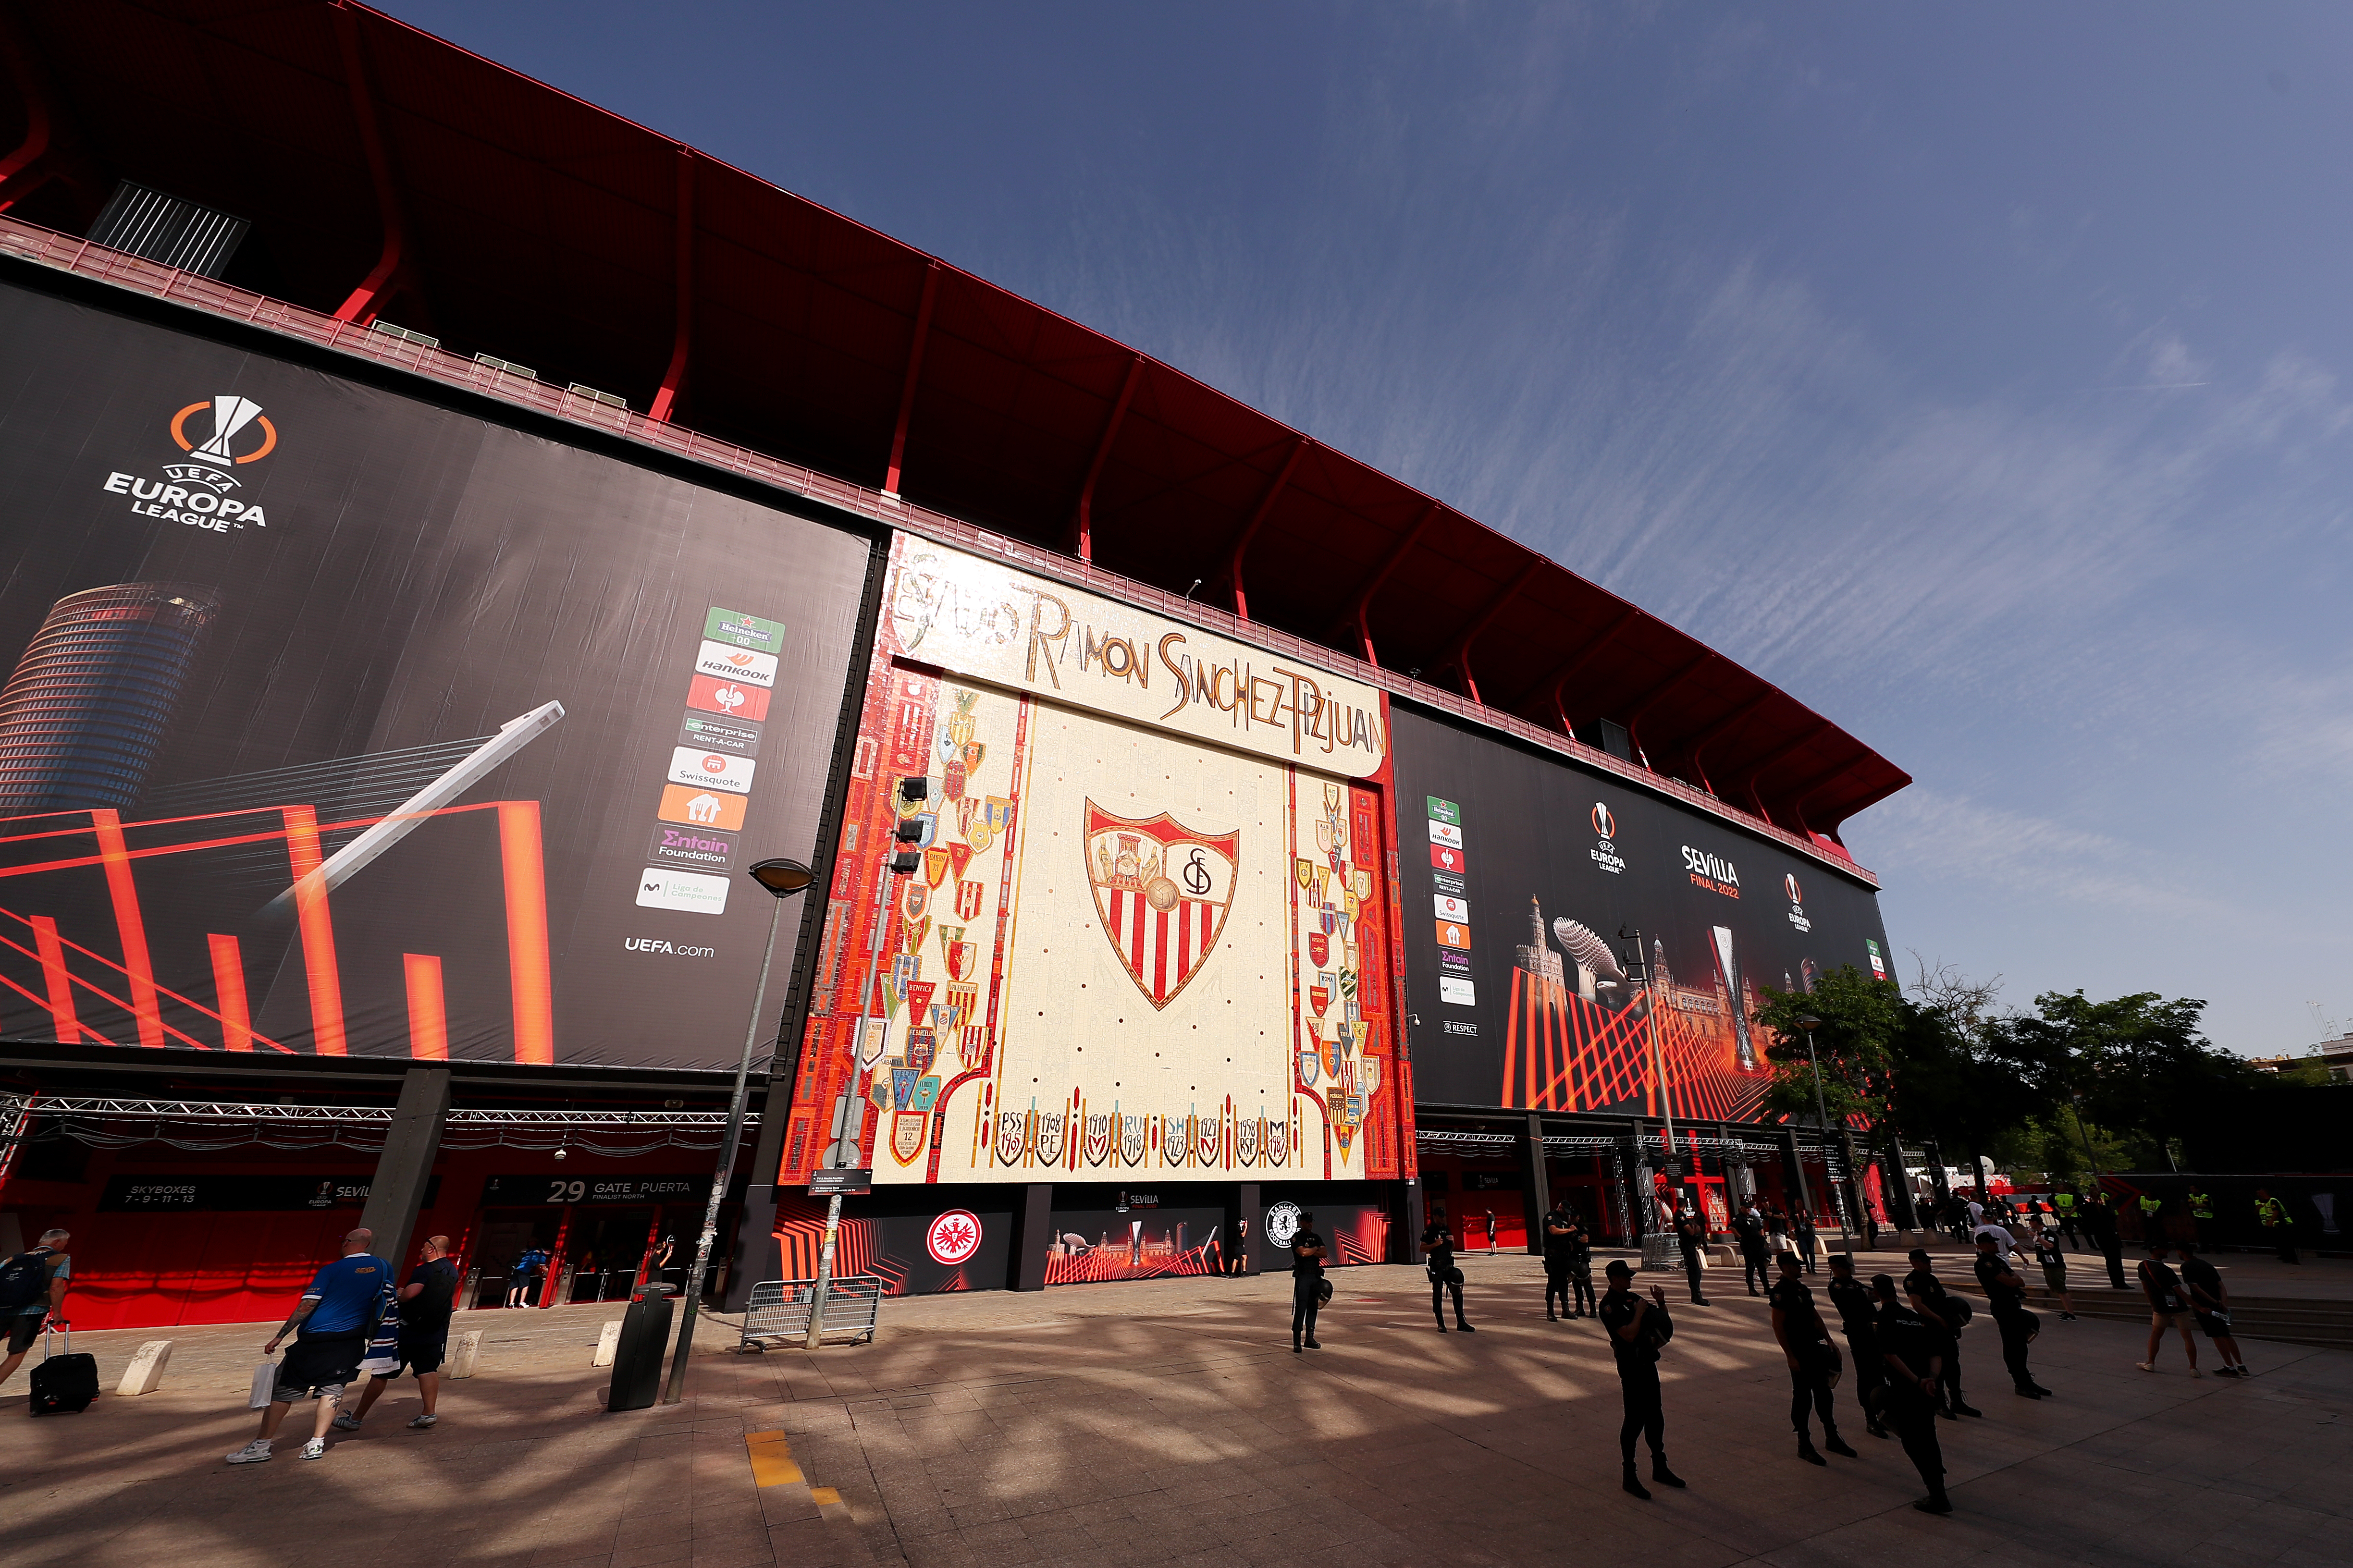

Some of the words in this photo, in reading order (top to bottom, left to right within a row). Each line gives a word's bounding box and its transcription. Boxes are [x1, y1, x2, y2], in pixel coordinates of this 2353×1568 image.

[166, 468, 234, 492] UEFA
[103, 471, 266, 527] EUROPA
[131, 501, 230, 533] LEAGUE
[721, 623, 768, 640] Heineken
[688, 722, 755, 739] enterprise
[693, 734, 744, 748] RENT-A-CAR
[679, 770, 740, 788] Swissquote
[1434, 806, 1454, 817] Heineken
[659, 846, 726, 863] Foundation
[1599, 843, 1614, 852] UEFA
[929, 854, 945, 862] BAYERN
[1590, 849, 1626, 869] EUROPA
[1599, 863, 1620, 874] LEAGUE
[673, 883, 690, 892] Liga
[1435, 875, 1463, 887] enterprise
[1439, 885, 1460, 894] RENT-A-CAR
[1690, 873, 1717, 892] FINAL
[1718, 883, 1739, 899] 2022
[671, 890, 722, 902] Campeones
[1439, 910, 1464, 920] Swissquote
[1788, 913, 1811, 928] EUROPA
[625, 937, 715, 958] UEFA.com
[1442, 962, 1469, 971] Foundation
[1453, 1024, 1477, 1033] RESPECT
[1042, 1113, 1061, 1134] 1908
[1088, 1114, 1107, 1135] 1910
[1200, 1118, 1216, 1138] 1929
[1239, 1119, 1255, 1138] 1958
[904, 1132, 912, 1140] 12
[1123, 1134, 1142, 1158] 1918
[1166, 1135, 1183, 1157] 1923
[1269, 1135, 1285, 1157] 1982
[547, 1181, 585, 1202] 29
[594, 1183, 631, 1192] GATE
[641, 1182, 690, 1192] PUERTA
[1270, 1203, 1299, 1217] RANGERS
